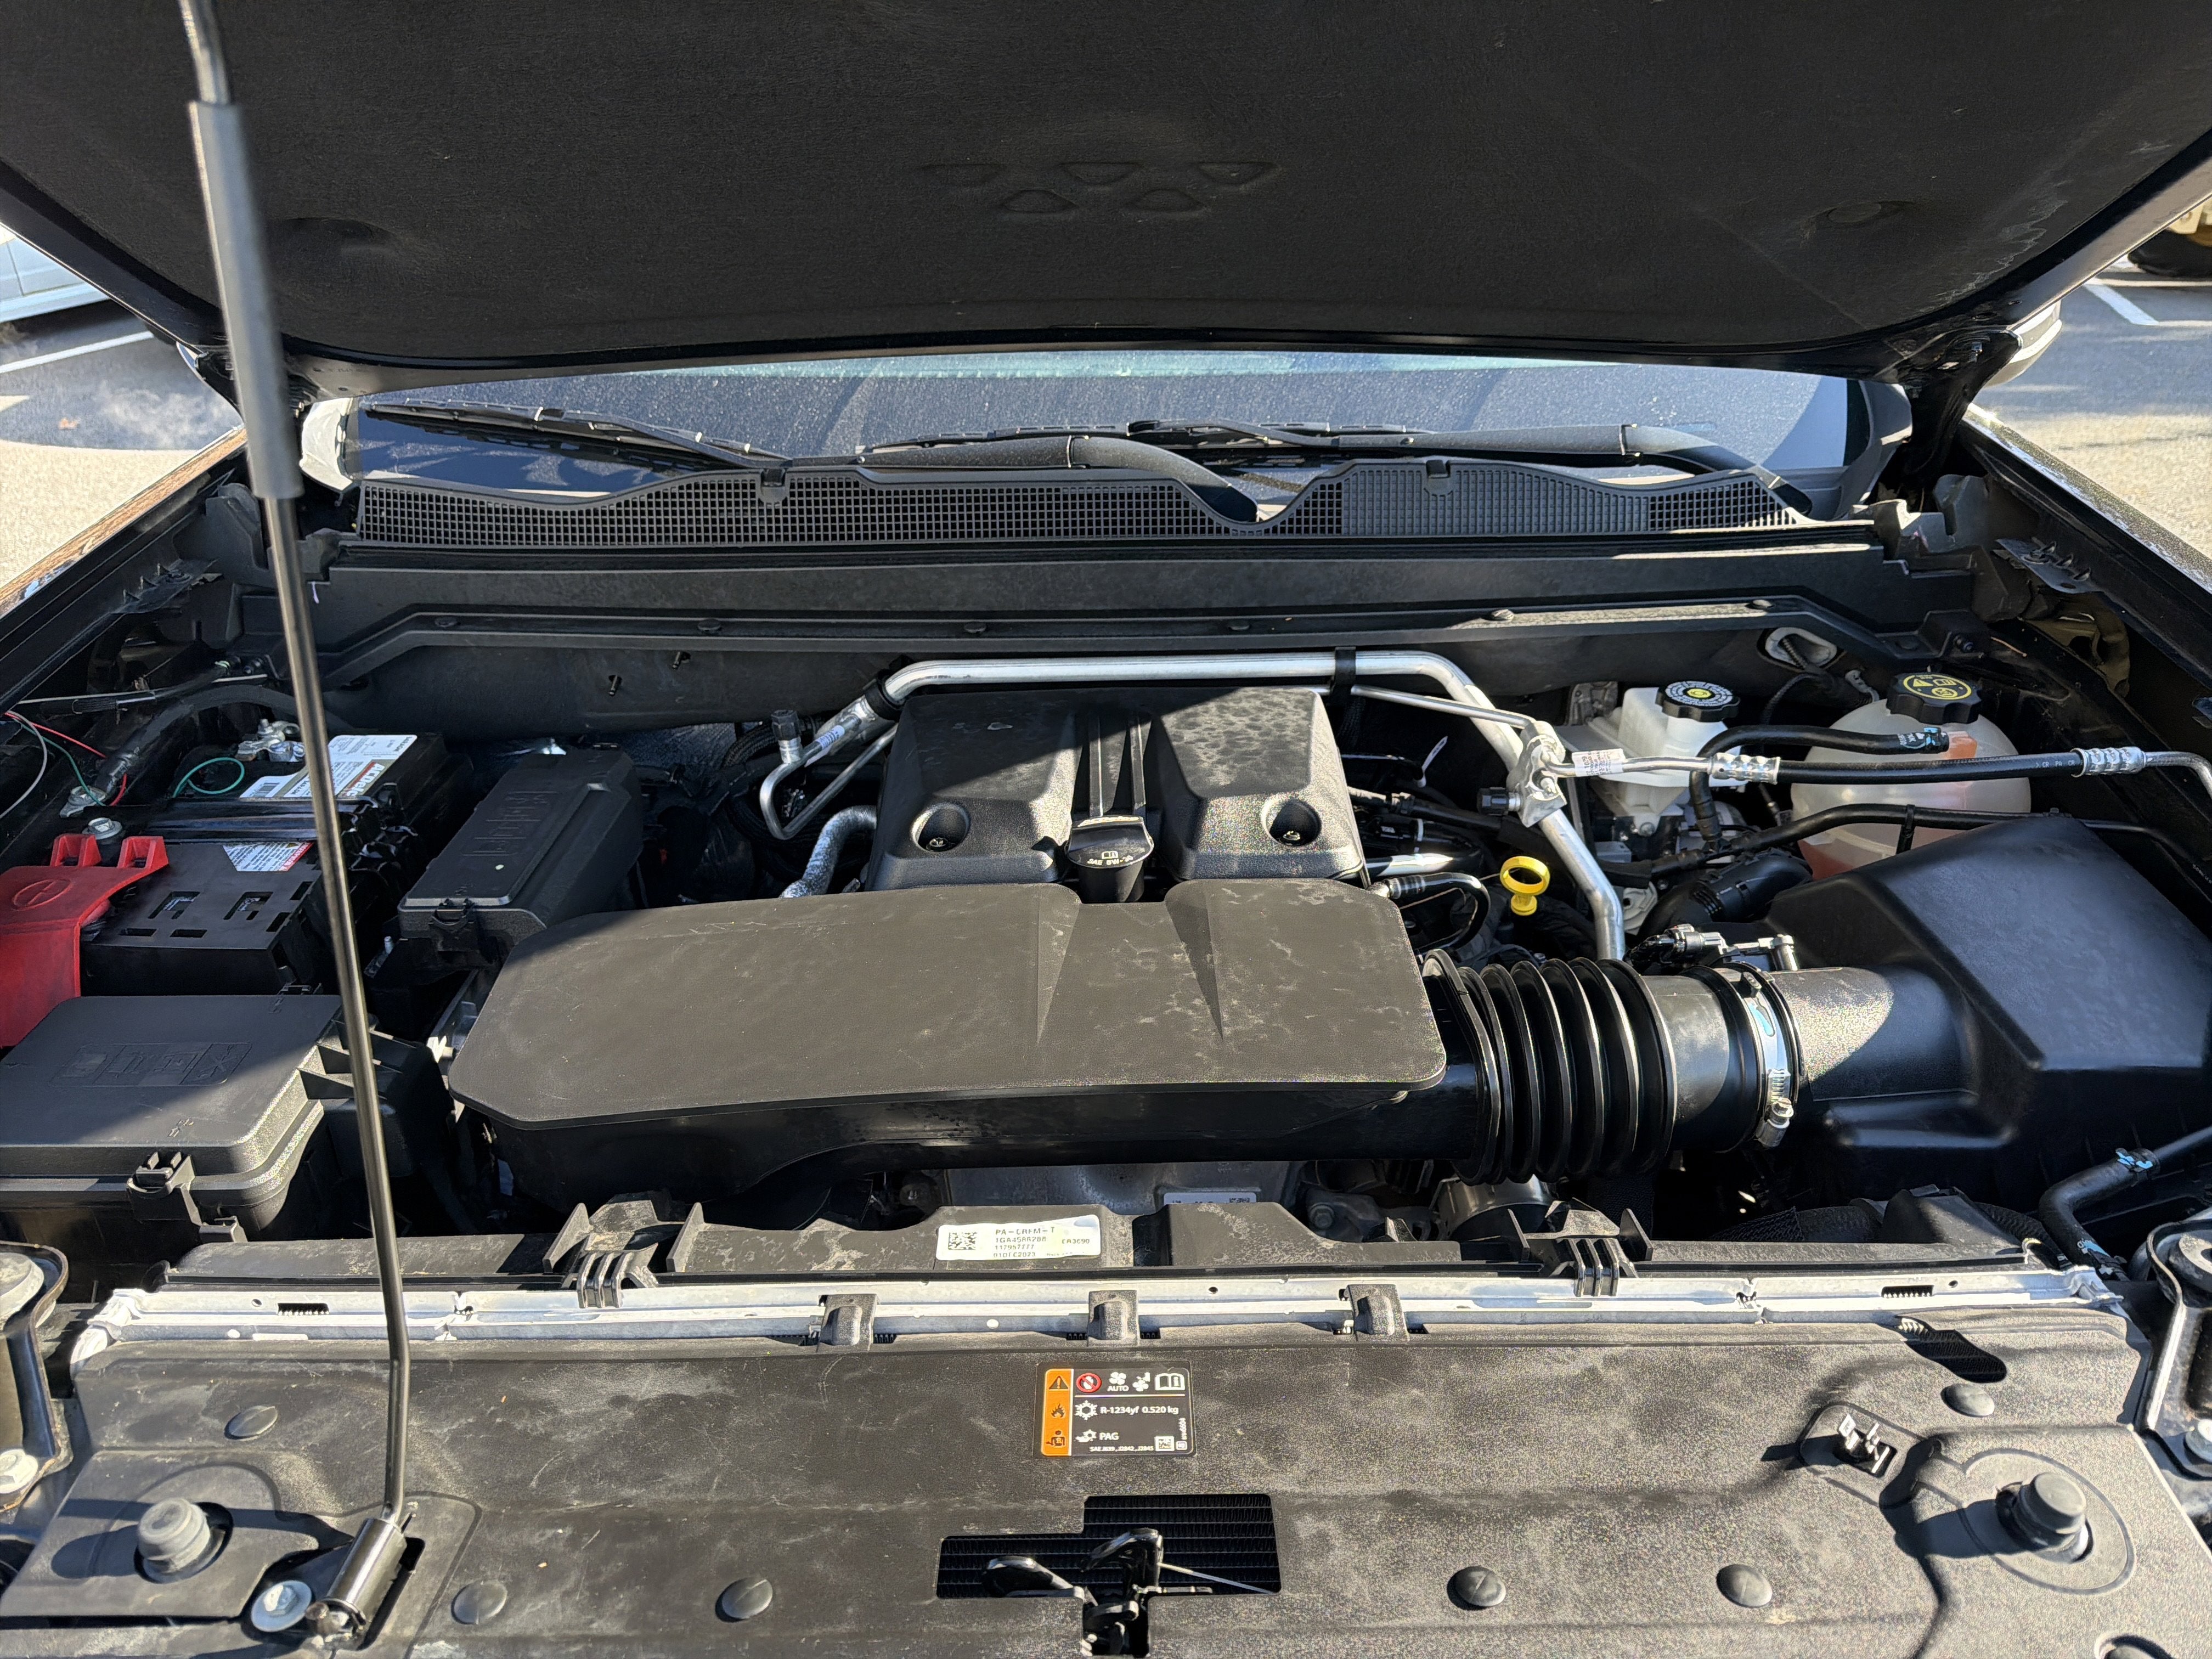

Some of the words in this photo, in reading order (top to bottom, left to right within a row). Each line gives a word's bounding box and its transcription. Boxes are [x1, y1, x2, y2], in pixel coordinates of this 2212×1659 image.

[345, 763, 386, 797] ACDelc
[1105, 855, 1134, 866] 5W-30
[1099, 1406, 1140, 1415] R-1234yf
[1142, 1406, 1166, 1414] 0.520
[1167, 1405, 1179, 1415] kg
[1099, 1432, 1119, 1441] PAG
